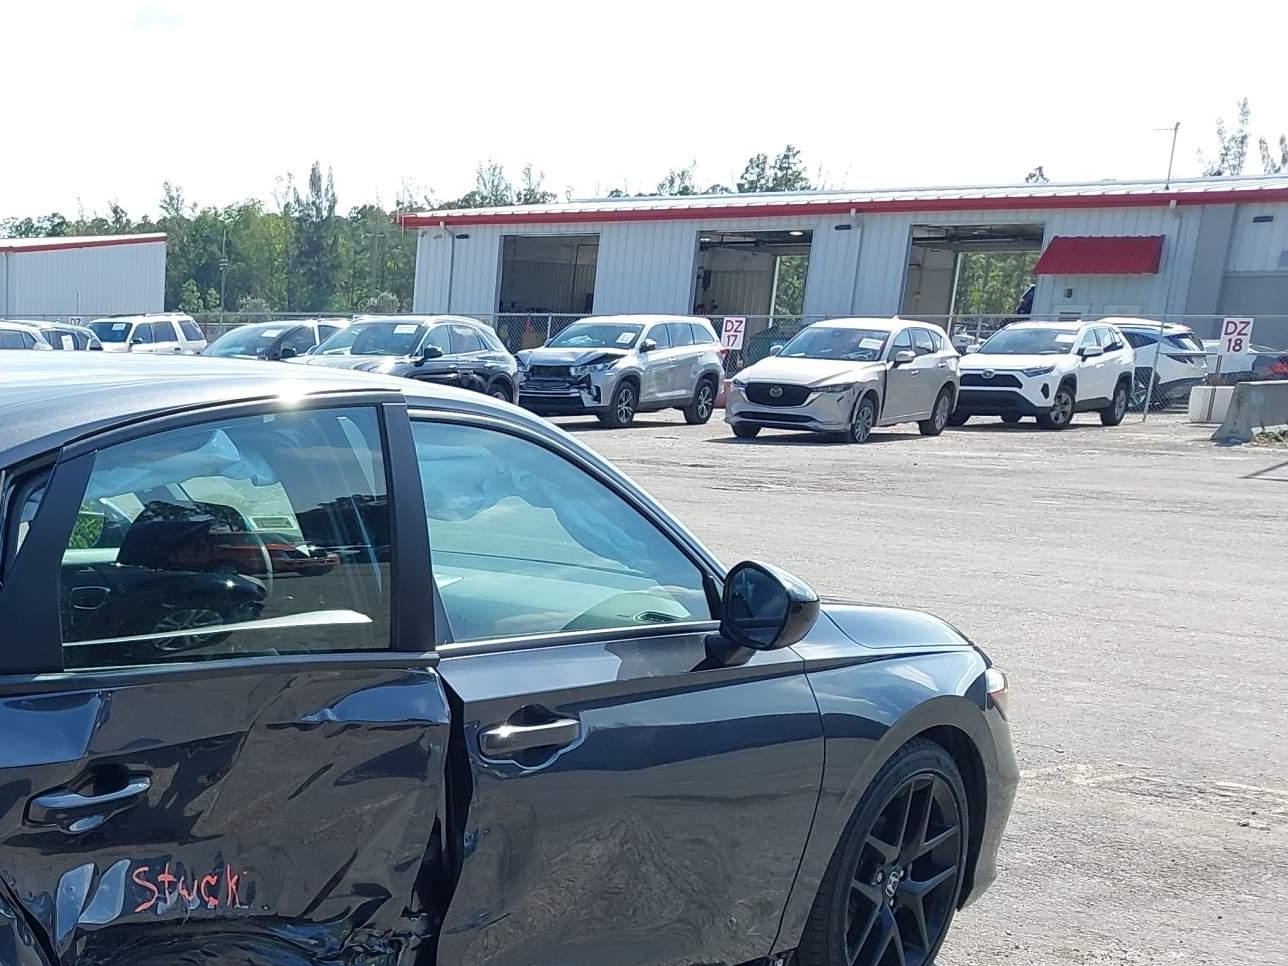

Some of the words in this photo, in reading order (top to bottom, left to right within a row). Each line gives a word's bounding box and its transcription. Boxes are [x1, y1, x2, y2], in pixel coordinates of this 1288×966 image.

[724, 319, 744, 333] DZ
[1223, 320, 1251, 336] DZ
[726, 334, 739, 347] 17
[1226, 338, 1243, 352] 18
